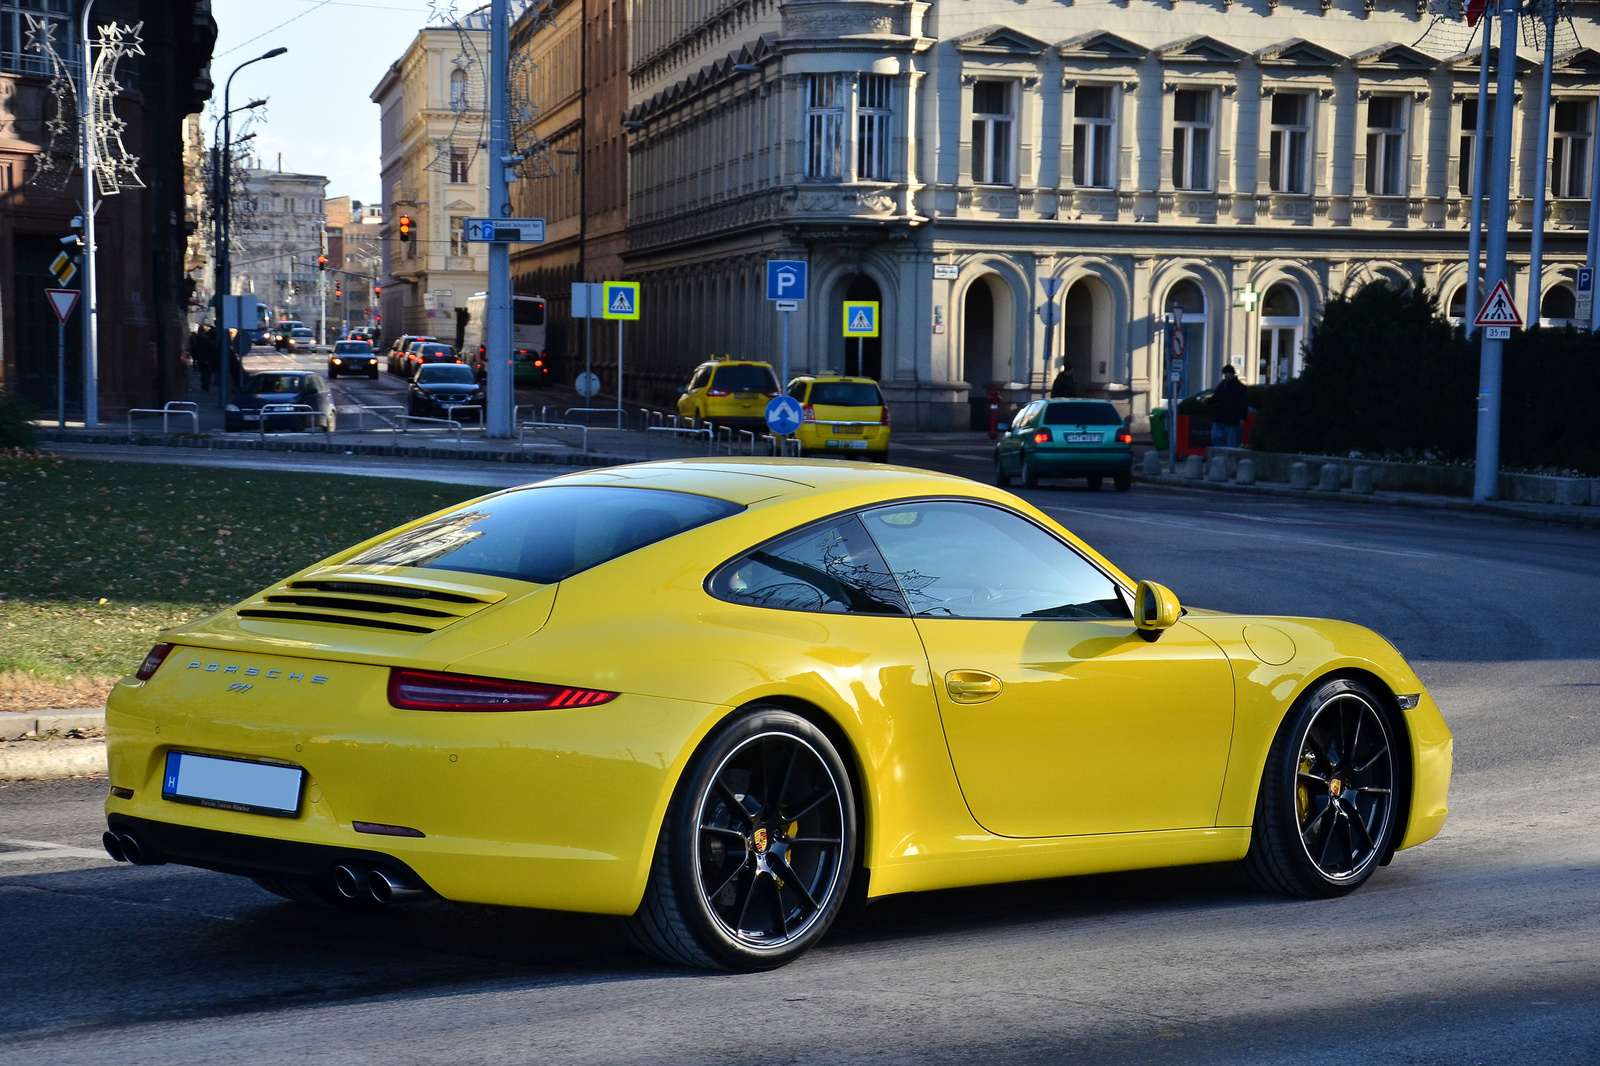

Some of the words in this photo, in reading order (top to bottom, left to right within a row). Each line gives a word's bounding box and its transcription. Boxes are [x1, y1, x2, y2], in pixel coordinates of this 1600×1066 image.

[777, 272, 796, 296] P
[1580, 272, 1590, 287] P
[1489, 328, 1499, 337] 35
[186, 660, 329, 685] PORSCHE
[226, 681, 254, 694] 911
[167, 776, 176, 788] H
